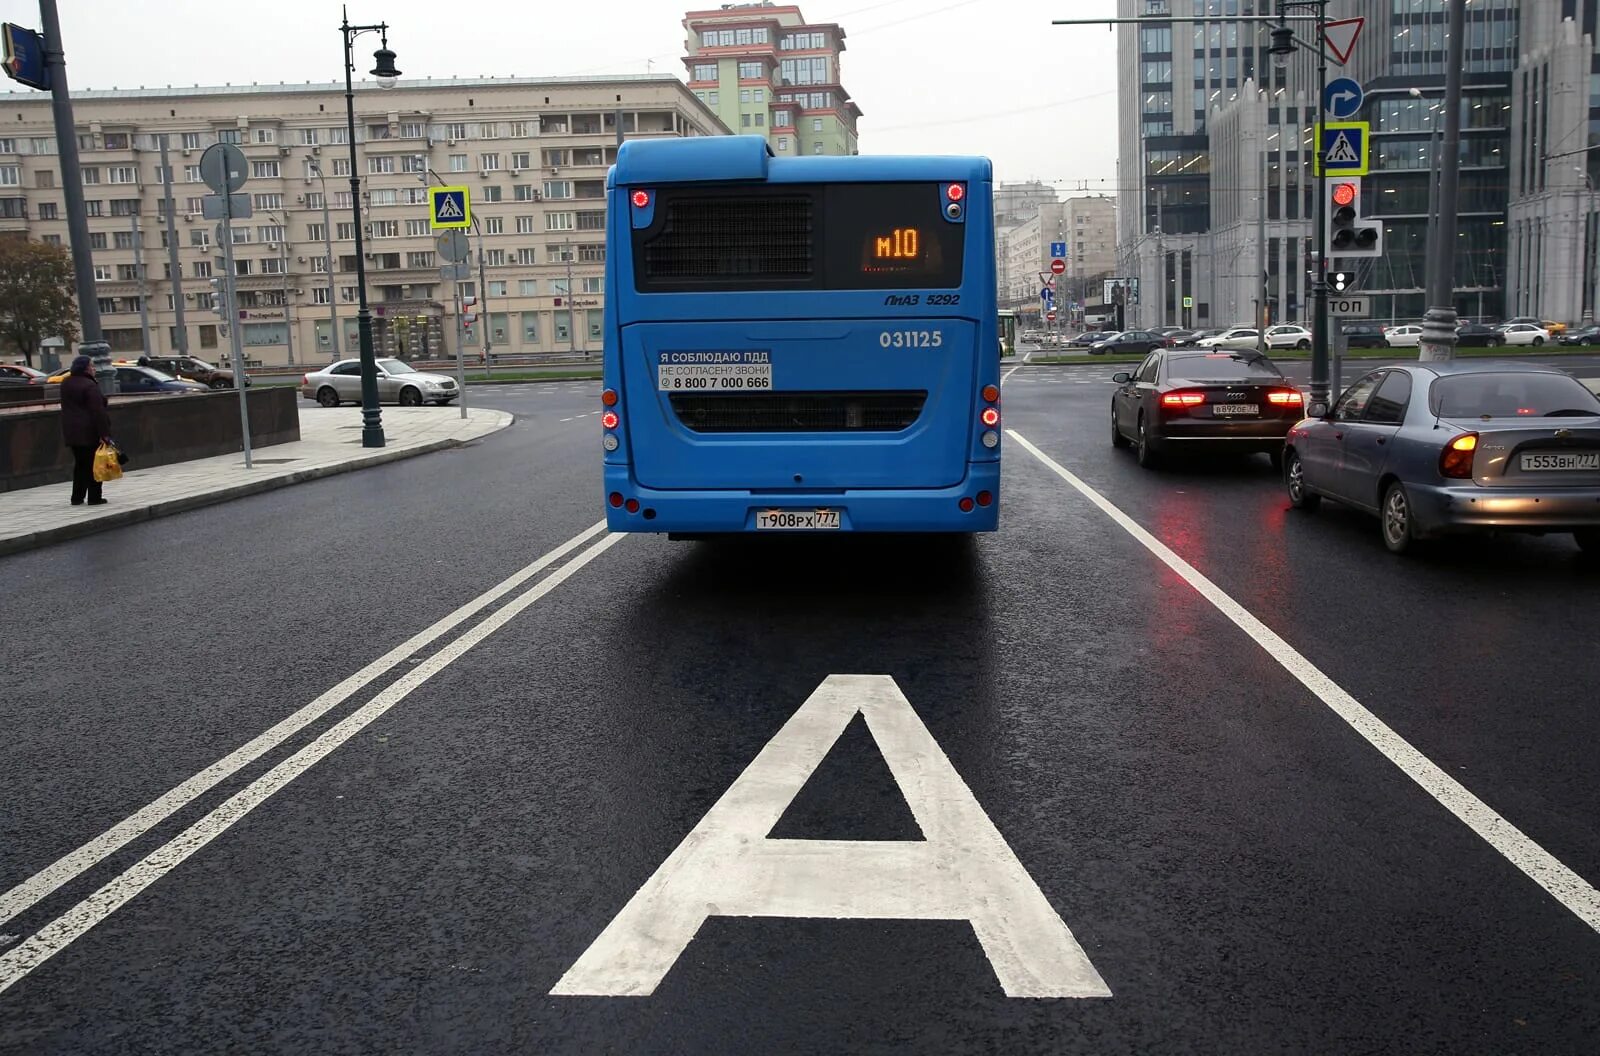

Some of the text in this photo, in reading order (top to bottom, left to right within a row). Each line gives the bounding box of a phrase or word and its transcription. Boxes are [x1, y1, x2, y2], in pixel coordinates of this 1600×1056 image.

[926, 294, 960, 306] 5292
[1329, 301, 1362, 312] ТОП
[879, 331, 942, 348] 031125
[660, 352, 769, 363] Я СОБЛЮДАЮ ПДД
[660, 366, 769, 375] НЕ СОГЛАСЕН? ЗВОНИ
[674, 377, 769, 388] 8 800 7 000 666
[1525, 454, 1596, 468] Т553ВН 777
[761, 513, 836, 527] Т908РХ 777
